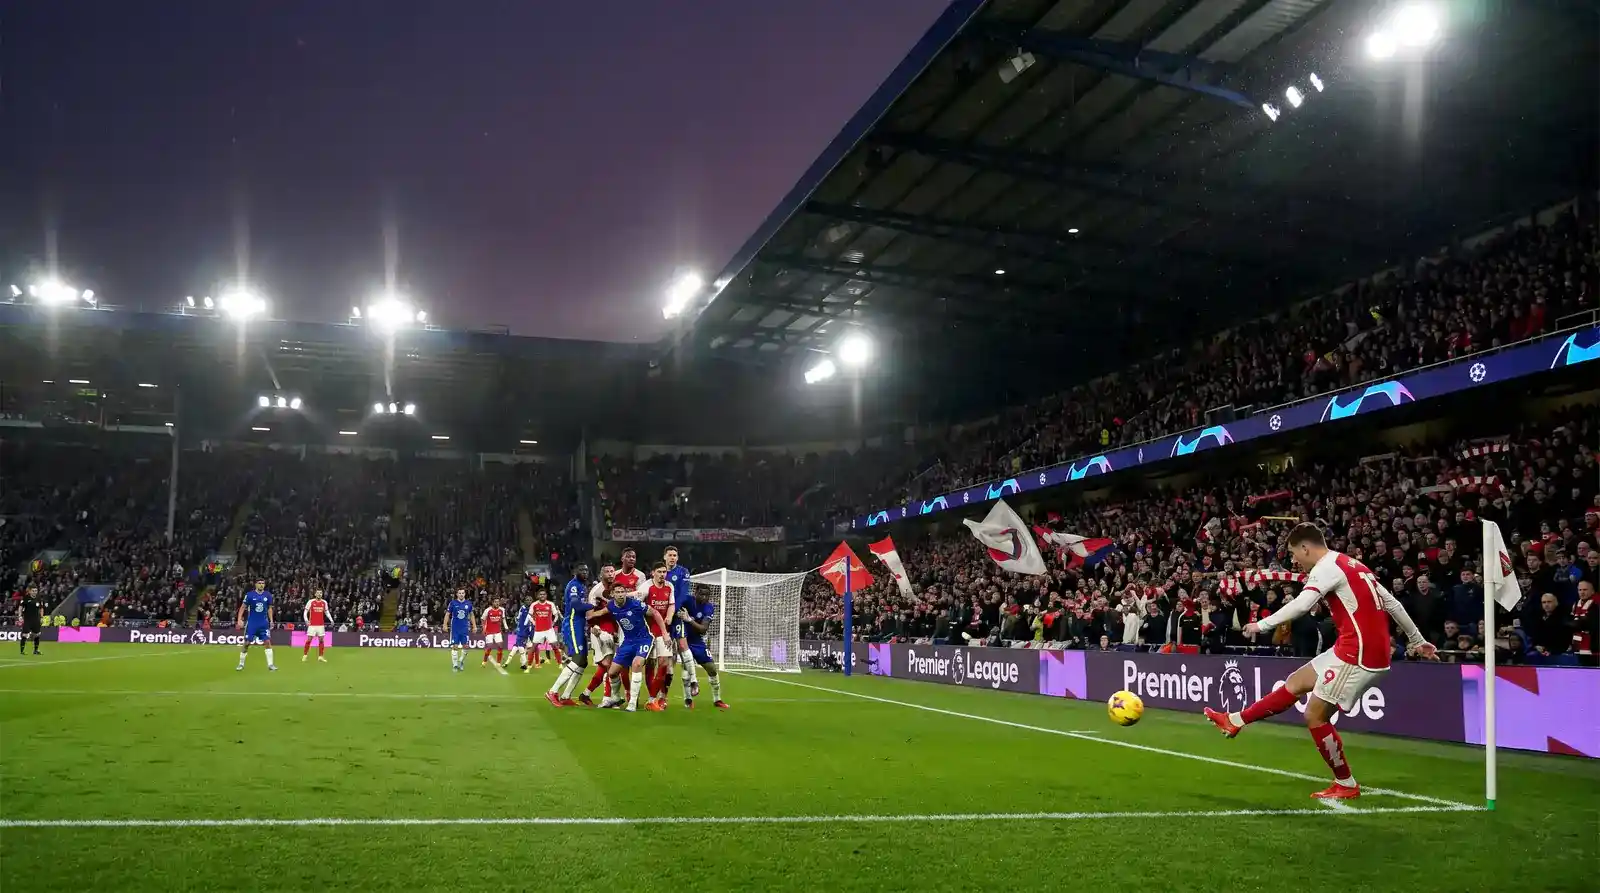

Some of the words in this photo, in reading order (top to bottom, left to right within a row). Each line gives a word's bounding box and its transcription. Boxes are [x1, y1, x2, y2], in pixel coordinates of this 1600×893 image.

[676, 625, 681, 634] 9
[130, 630, 188, 643] Premier
[209, 631, 264, 646] Leag
[359, 634, 412, 647] Premier
[433, 635, 485, 648] Leue
[639, 644, 649, 653] 10
[908, 650, 950, 676] Premier
[967, 651, 1018, 688] League
[1322, 669, 1336, 685] 9
[1123, 659, 1213, 702] Premier
